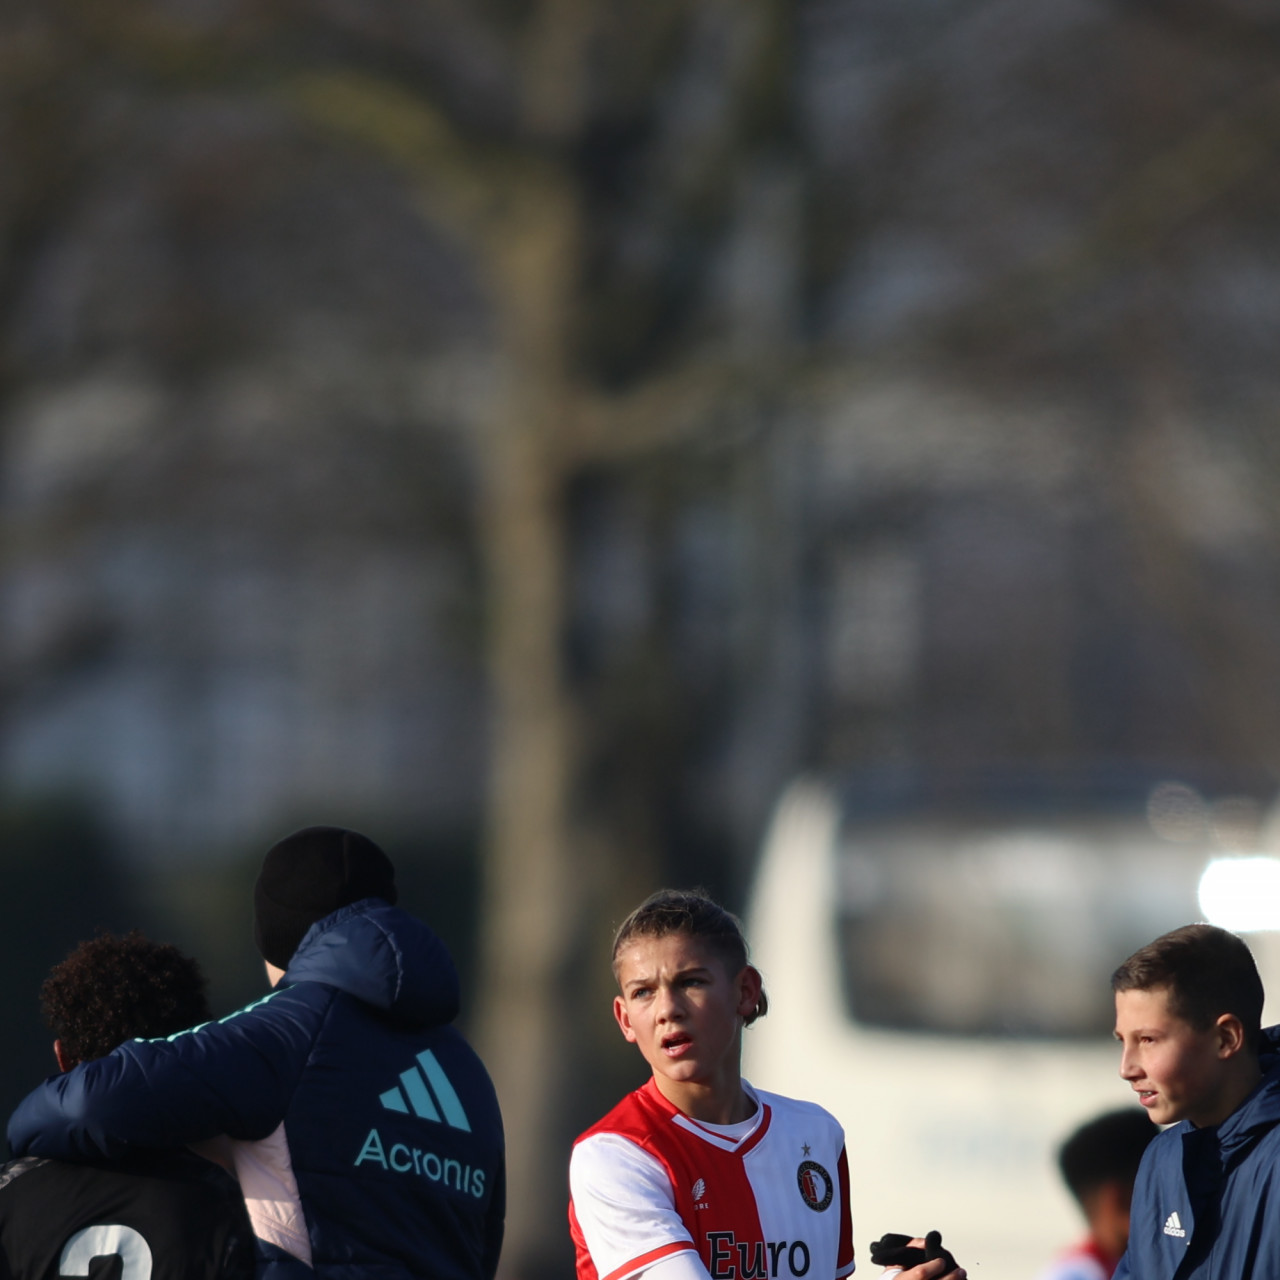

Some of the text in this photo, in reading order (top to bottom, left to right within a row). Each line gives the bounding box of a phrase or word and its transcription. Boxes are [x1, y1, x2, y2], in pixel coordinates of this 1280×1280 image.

[354, 1128, 486, 1198] Acronis
[706, 1231, 810, 1280] Euro
[1163, 1226, 1186, 1238] adidas
